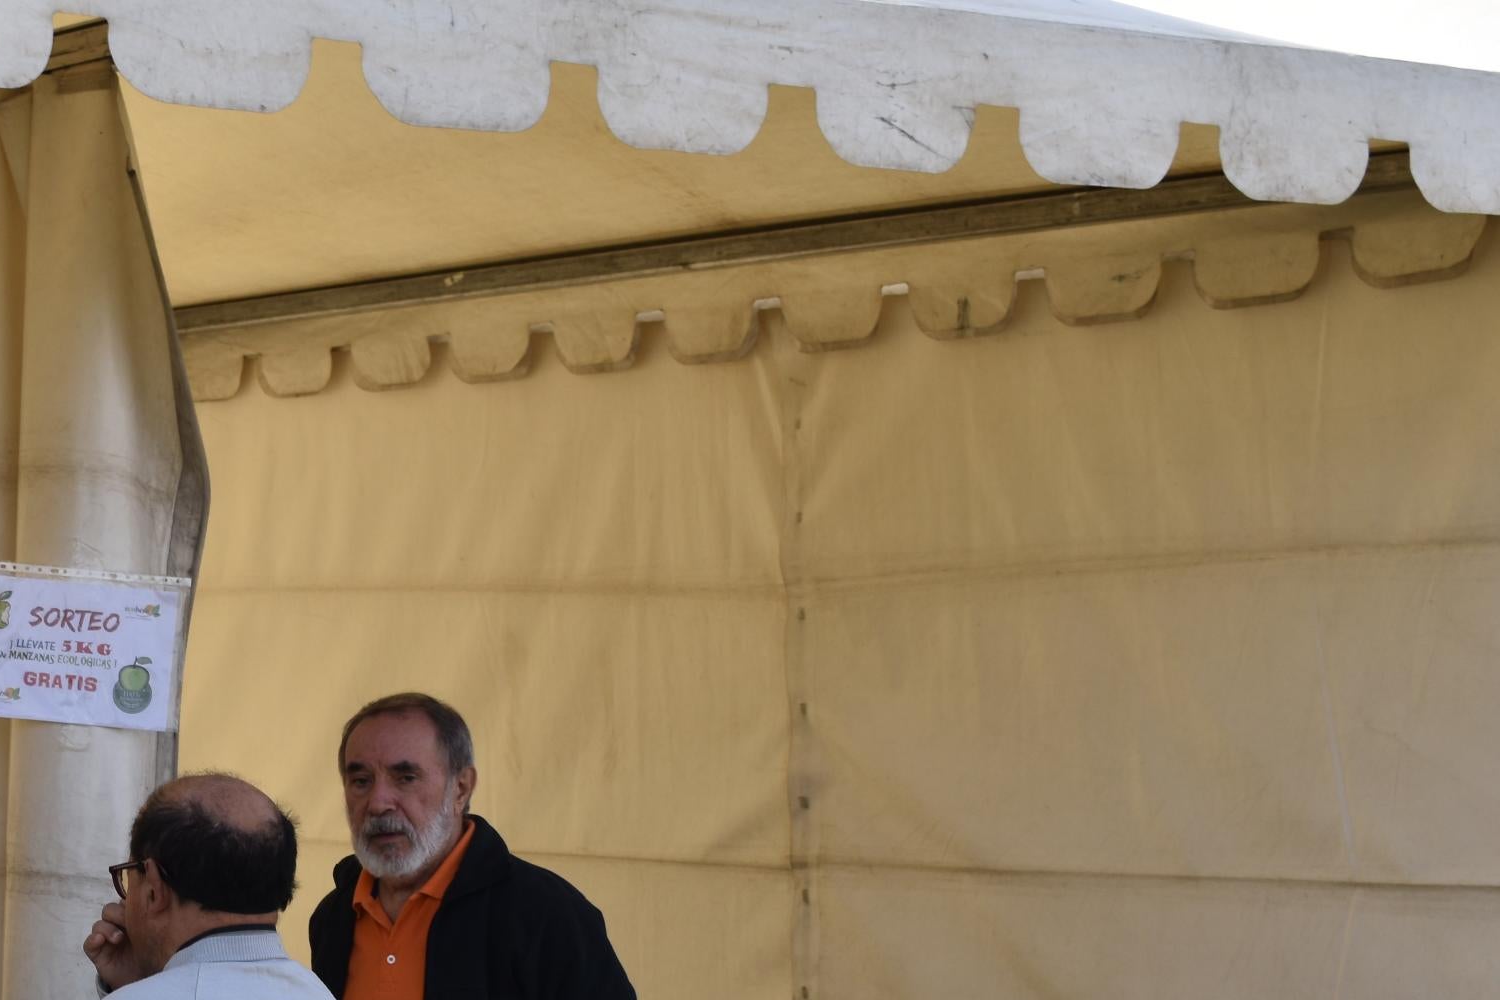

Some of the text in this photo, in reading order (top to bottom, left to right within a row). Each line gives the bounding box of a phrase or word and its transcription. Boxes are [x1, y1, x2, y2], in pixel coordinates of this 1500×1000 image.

[28, 606, 121, 633] SORTEO
[9, 650, 55, 665] MANZANAS
[23, 671, 98, 692] GRATIS
